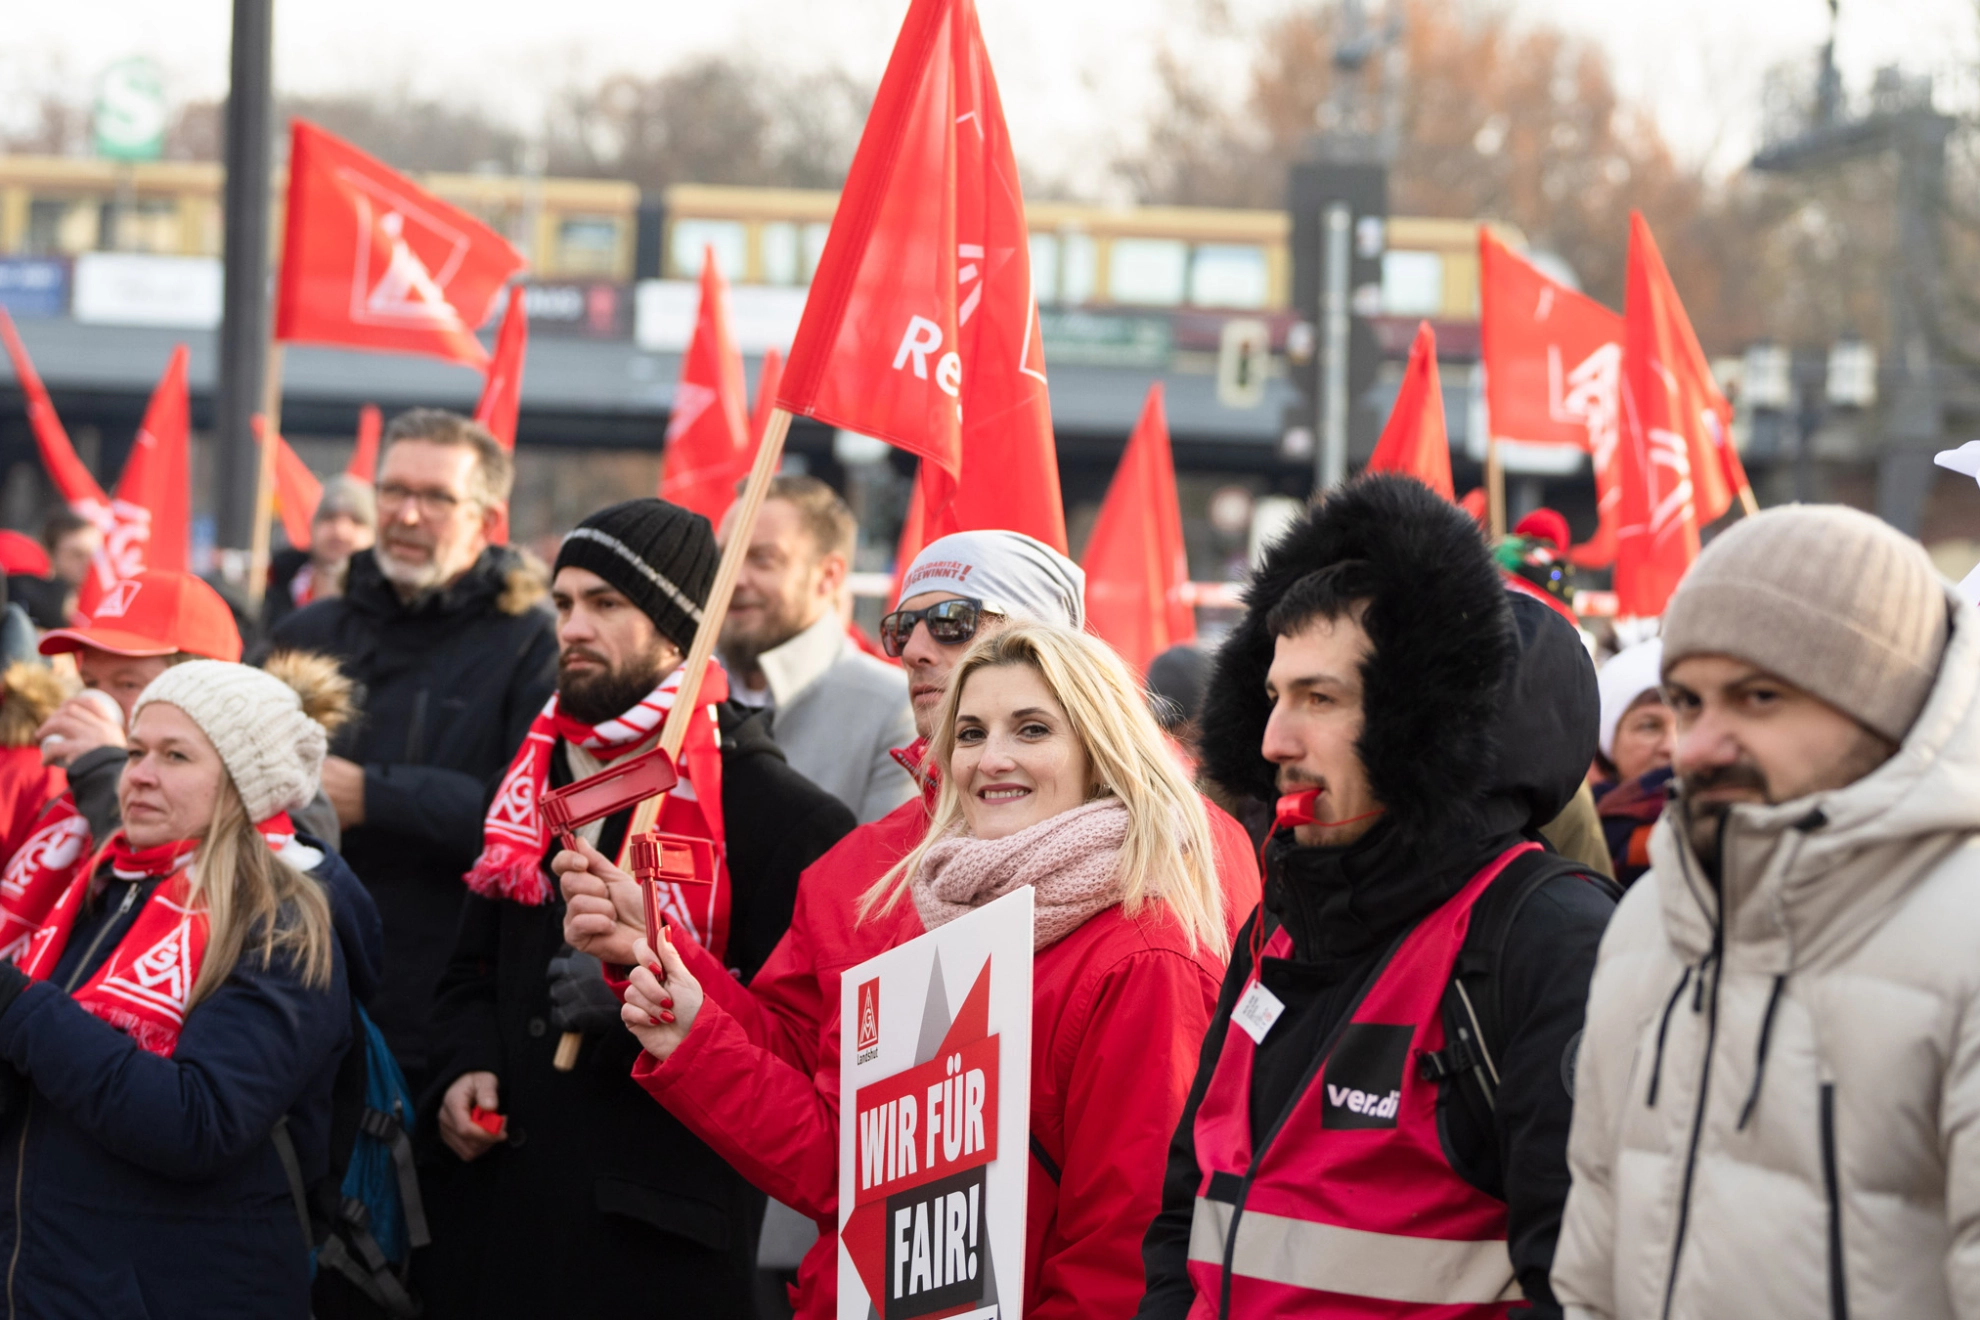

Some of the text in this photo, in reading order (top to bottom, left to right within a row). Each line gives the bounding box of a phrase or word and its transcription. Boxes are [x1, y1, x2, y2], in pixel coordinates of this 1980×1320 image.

[857, 1046, 879, 1066] Landshut
[860, 1052, 986, 1191] WIR FÜR
[1327, 1083, 1401, 1119] ver.di
[894, 1183, 980, 1299] FAIR!
